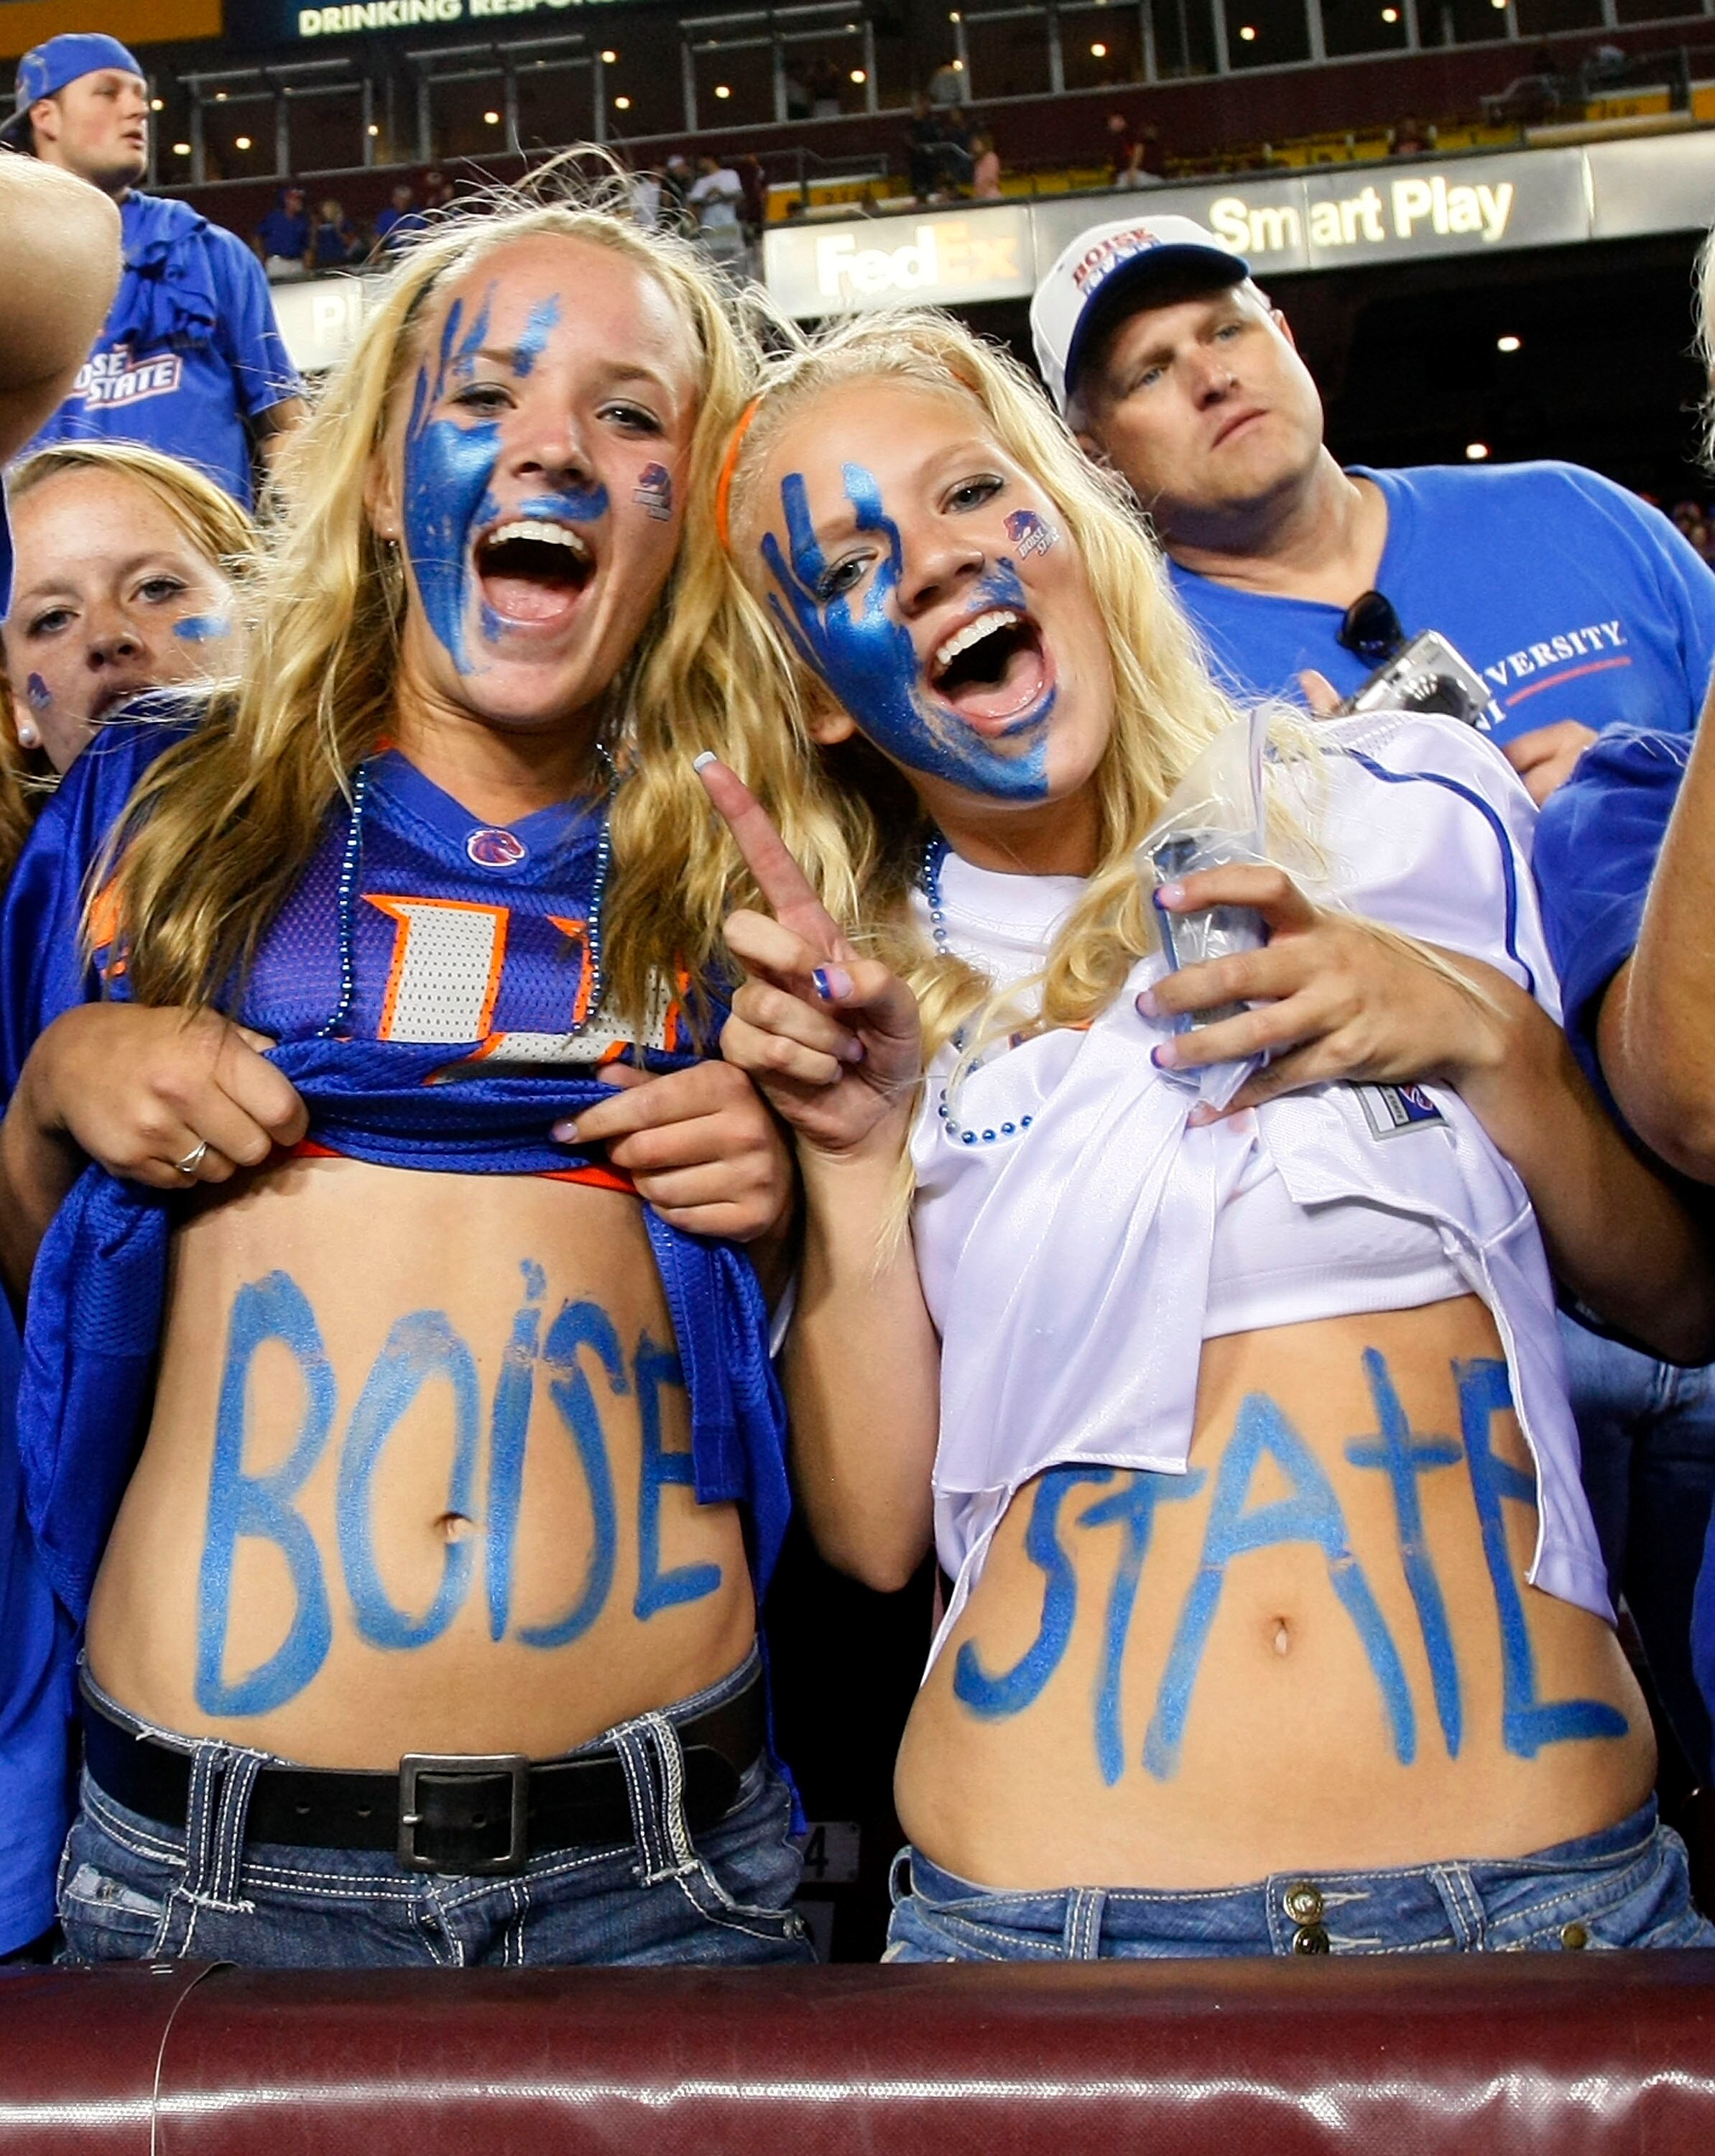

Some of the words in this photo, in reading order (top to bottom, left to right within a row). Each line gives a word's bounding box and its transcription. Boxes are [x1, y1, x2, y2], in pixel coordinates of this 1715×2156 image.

[299, 0, 462, 36] DRINKING
[1391, 175, 1514, 242] Play
[816, 221, 1018, 296] FedEx
[85, 361, 175, 402] STATE
[1483, 620, 1621, 686] VERSITY
